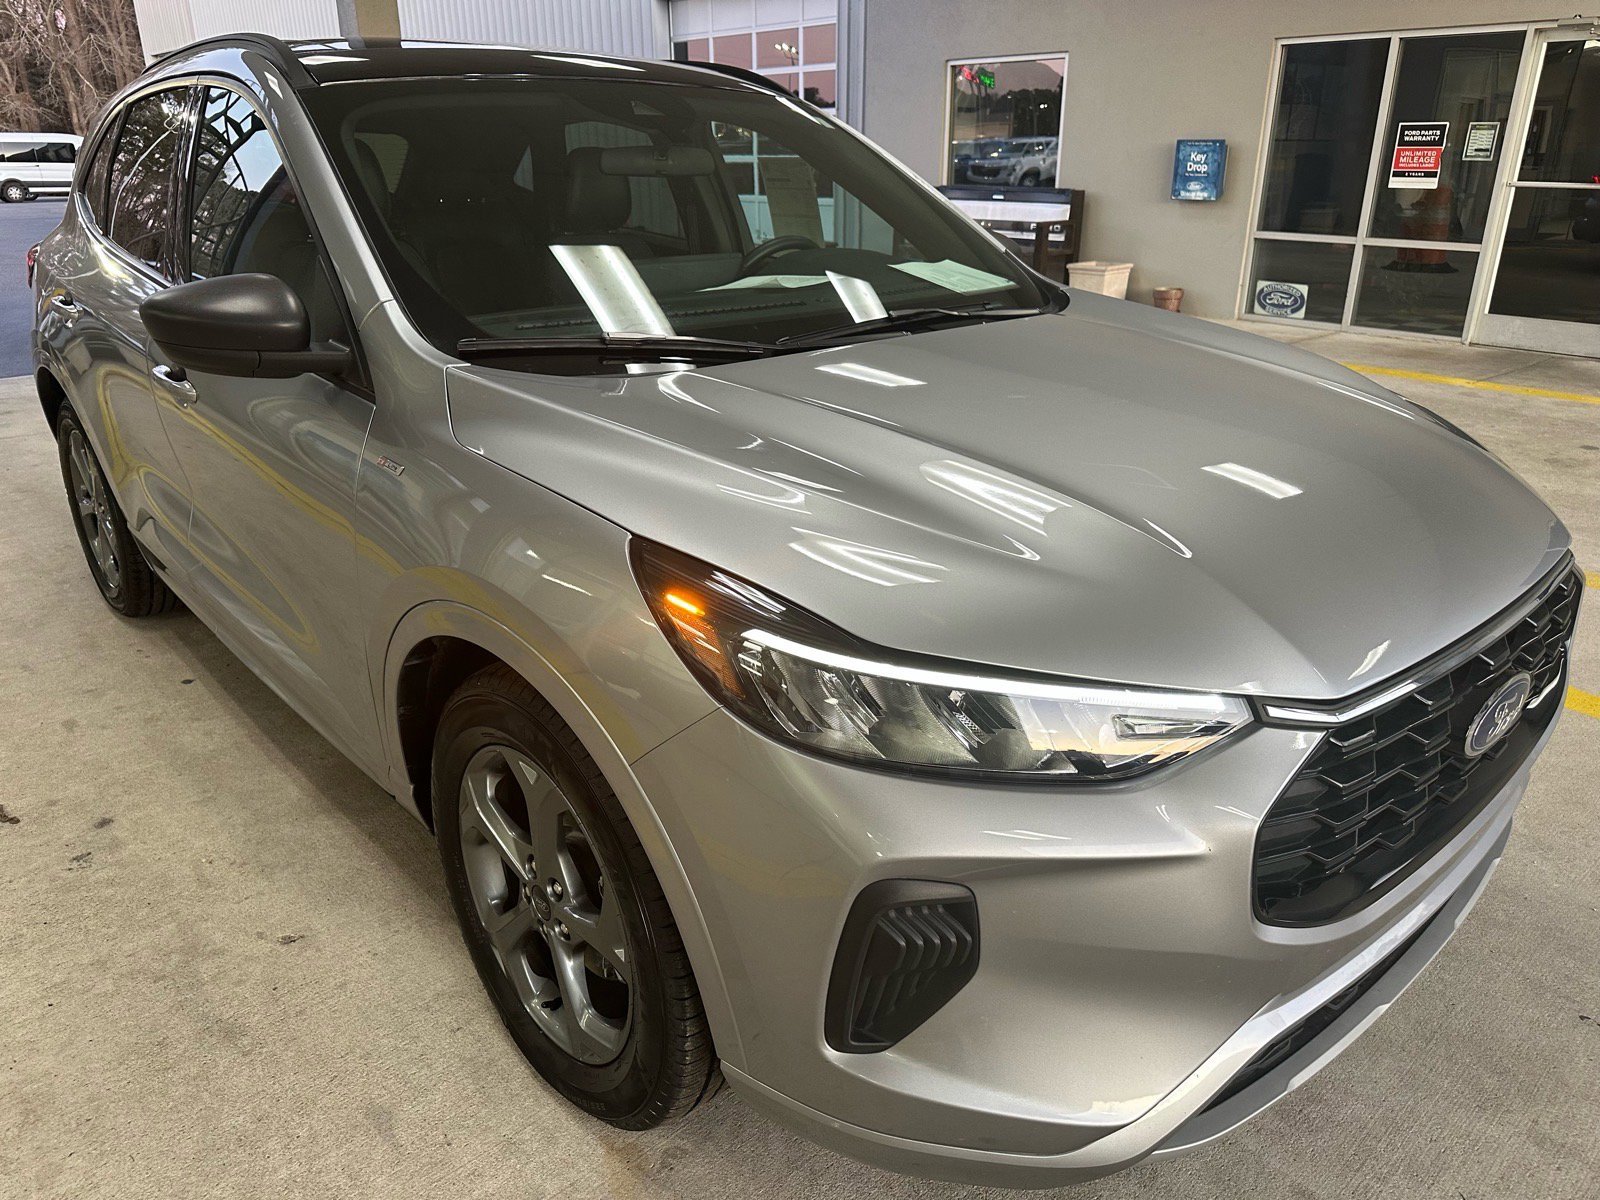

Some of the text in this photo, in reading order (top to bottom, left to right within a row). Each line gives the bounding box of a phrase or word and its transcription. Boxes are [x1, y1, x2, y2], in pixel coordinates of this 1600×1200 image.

[1190, 152, 1207, 163] Key
[1187, 162, 1207, 173] Drop
[1264, 284, 1301, 296] AUTHORIZED
[1265, 292, 1295, 306] Ford
